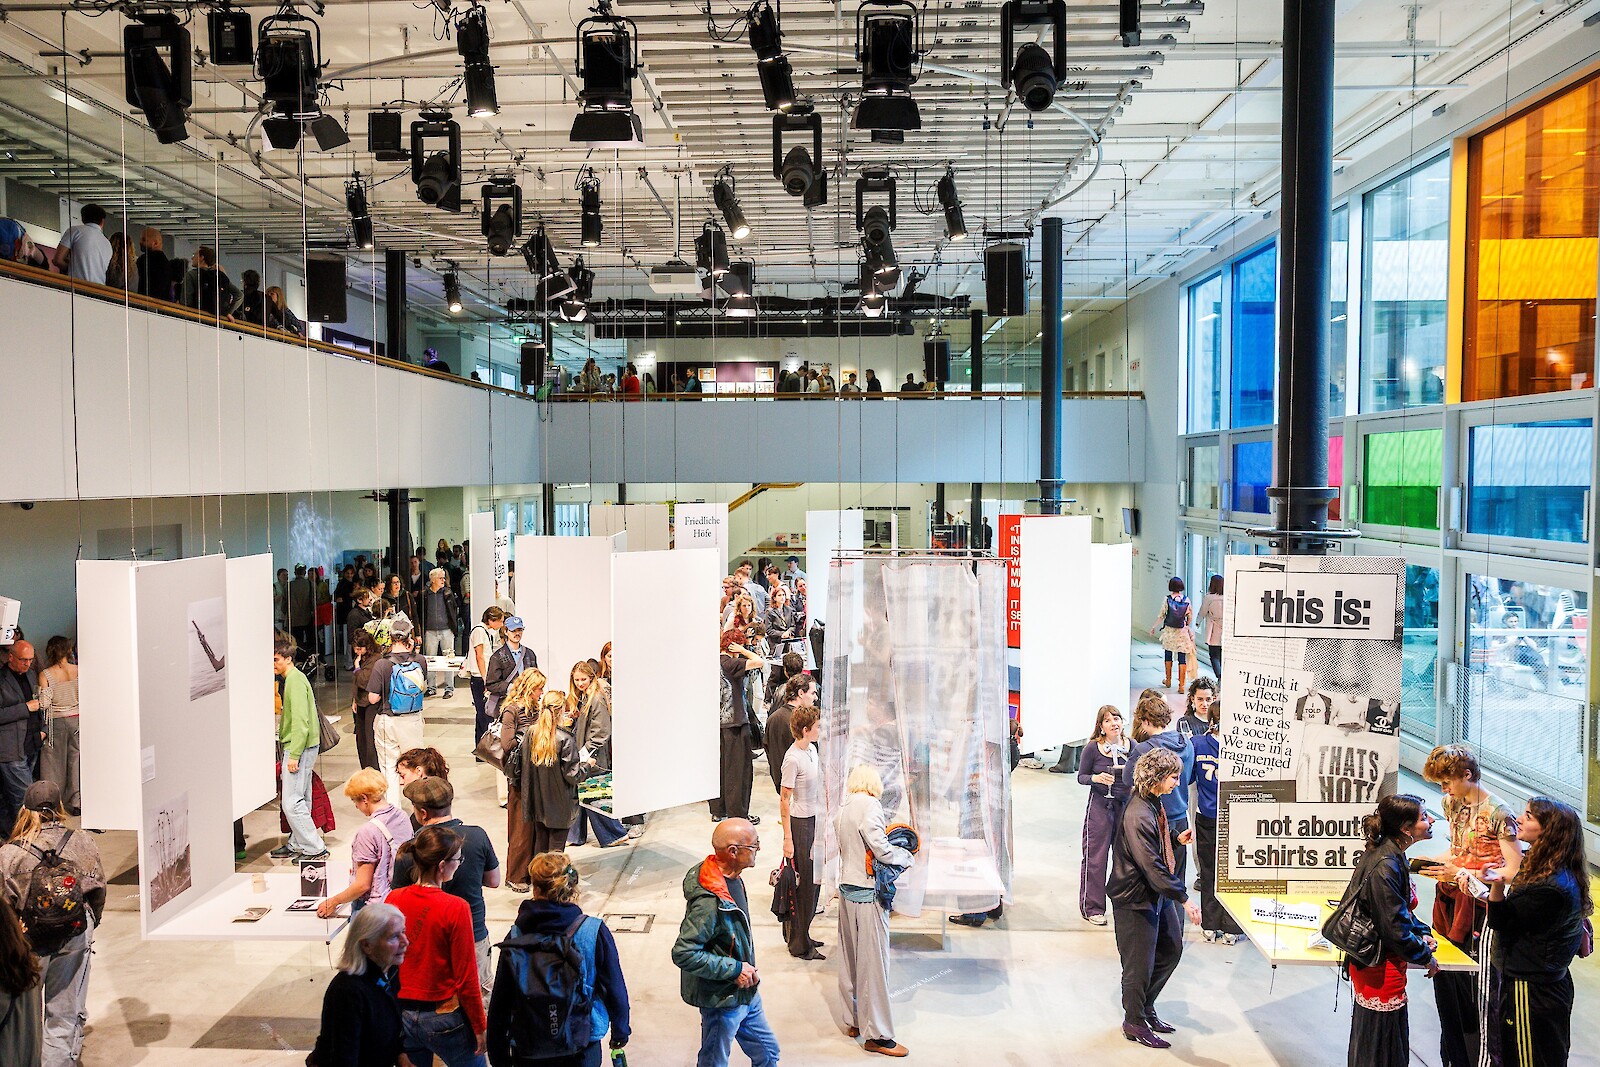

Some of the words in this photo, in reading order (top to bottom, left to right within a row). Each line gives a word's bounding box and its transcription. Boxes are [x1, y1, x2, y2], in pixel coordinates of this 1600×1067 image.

[684, 516, 721, 526] Friedliche
[494, 535, 508, 548] eus
[693, 528, 712, 538] Höfe
[1261, 589, 1324, 625] this
[1333, 590, 1371, 626] is:
[1253, 672, 1286, 690] think
[1289, 679, 1299, 692] it
[1242, 686, 1289, 704] reflects
[1244, 699, 1284, 715] where
[1232, 712, 1252, 724] we
[1254, 716, 1274, 728] are
[1276, 719, 1291, 730] as
[1232, 726, 1240, 735] a
[1242, 725, 1290, 744] society.
[1222, 734, 1243, 749] We
[1246, 739, 1266, 751] are
[1269, 741, 1281, 754] in
[1285, 746, 1293, 757] a
[1220, 747, 1291, 769] fragmented
[1318, 745, 1379, 783] THATS
[1256, 815, 1292, 837] not
[1298, 815, 1361, 837] about
[1236, 844, 1318, 867] t-shirts
[1325, 845, 1347, 867] at
[549, 1004, 559, 1036] EXPED
